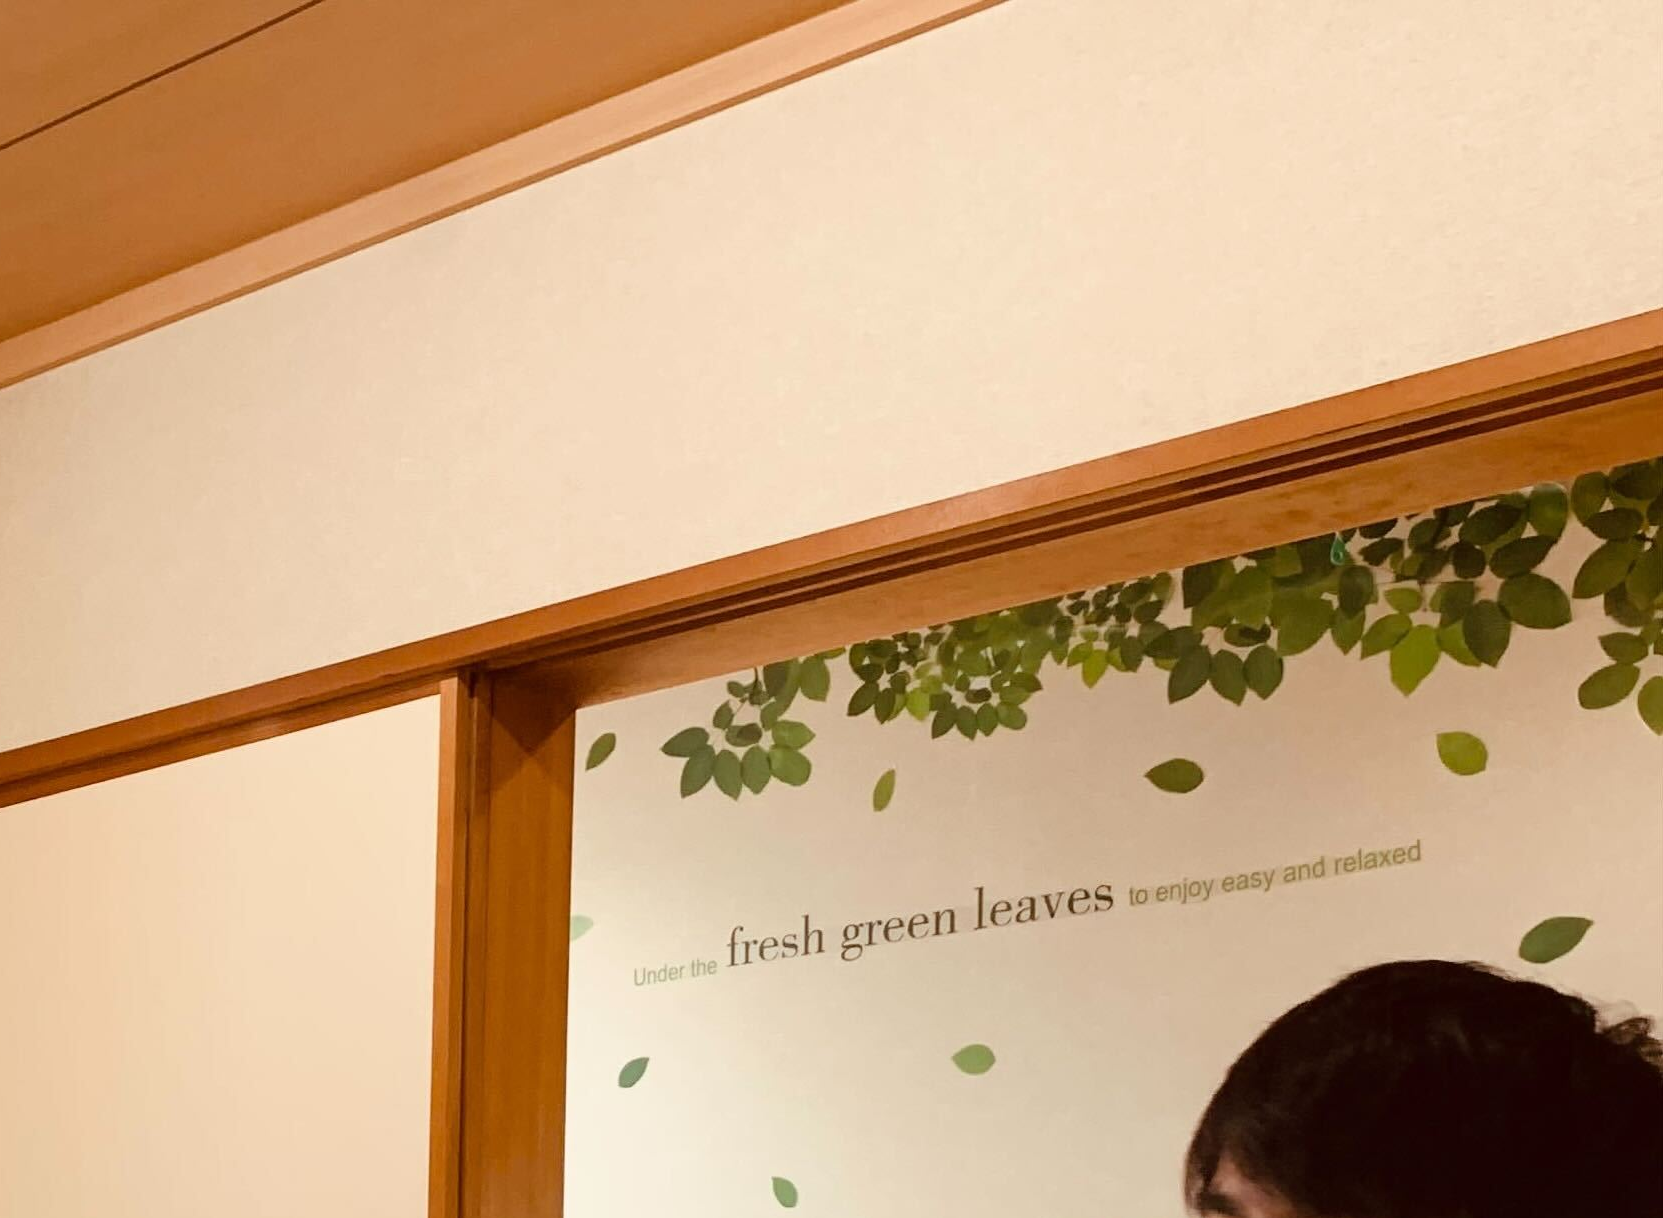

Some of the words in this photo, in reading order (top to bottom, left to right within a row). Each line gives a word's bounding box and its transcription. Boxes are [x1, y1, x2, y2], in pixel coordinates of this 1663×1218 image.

[633, 962, 686, 987] Under
[690, 958, 718, 979] the
[726, 914, 826, 968] fresh
[840, 906, 957, 961] green
[973, 883, 1114, 931] leaves
[1128, 886, 1148, 907] to
[1155, 878, 1215, 905] enjoy
[1221, 868, 1275, 894] easy
[1283, 856, 1326, 884] and
[1334, 839, 1423, 877] relaxed
